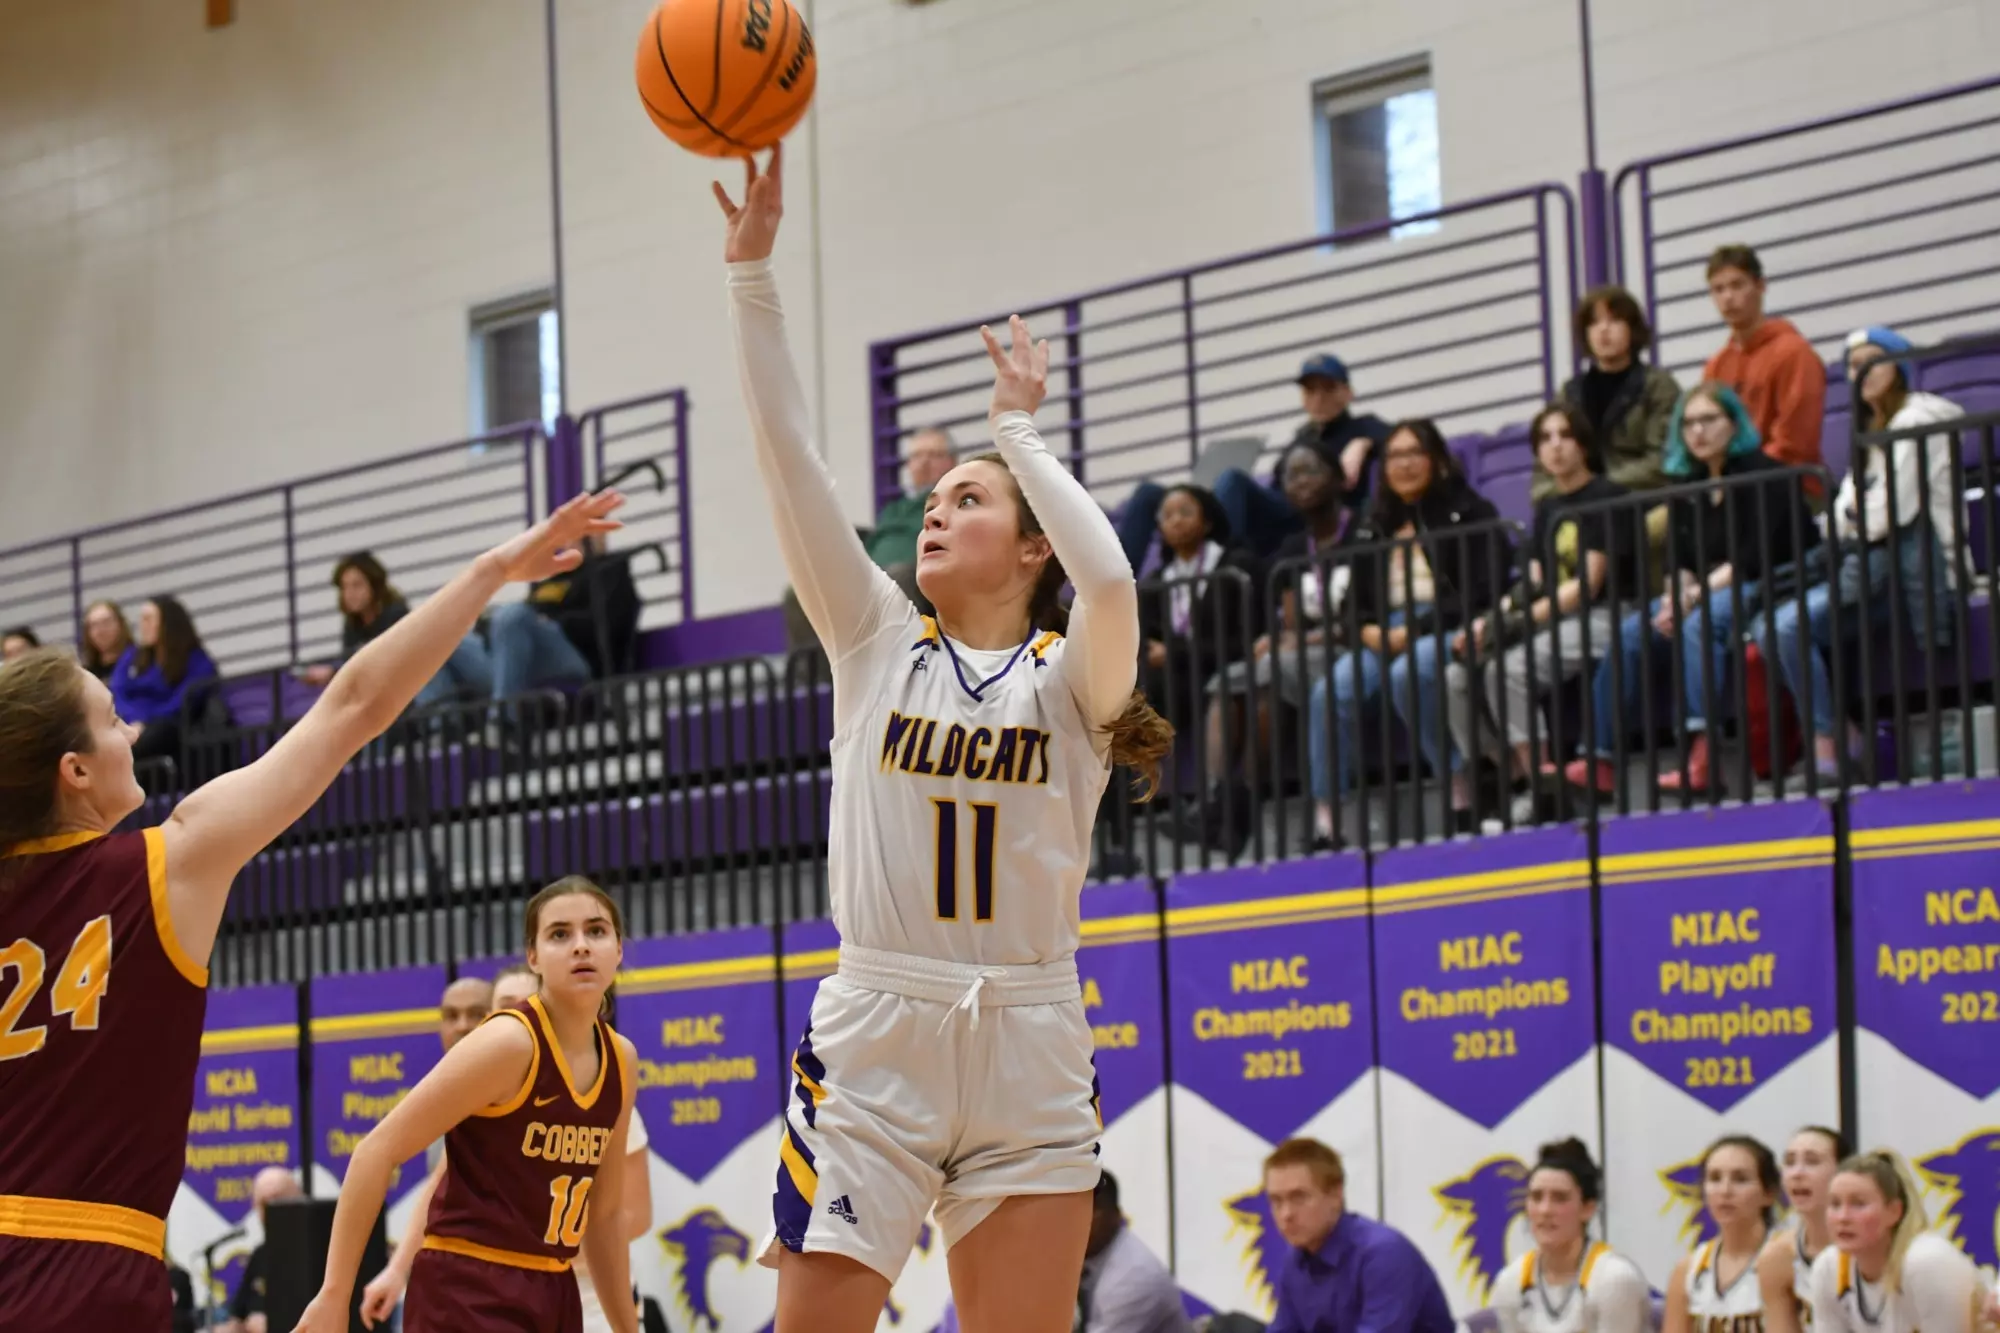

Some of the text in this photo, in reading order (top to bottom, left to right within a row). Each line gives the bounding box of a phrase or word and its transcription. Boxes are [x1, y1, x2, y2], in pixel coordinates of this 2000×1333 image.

[880, 709, 1051, 784] WILDCATS
[929, 797, 998, 923] 11
[1671, 908, 1760, 946] MIAC
[1440, 931, 1522, 971] MIAC
[1877, 943, 2000, 984] Appear
[0, 914, 113, 1061] 24
[1231, 955, 1309, 993] MIAC
[1660, 953, 1775, 998] Playoff
[1401, 977, 1569, 1021] Champions
[1942, 991, 2000, 1024] 202
[662, 1014, 724, 1047] MIAC
[1193, 1000, 1351, 1040] Champions
[1631, 1003, 1812, 1045] Champions
[1243, 1050, 1303, 1080] 2021
[1454, 1029, 1517, 1061] 2021
[1685, 1056, 1754, 1087] 2021
[544, 1174, 594, 1247] 10
